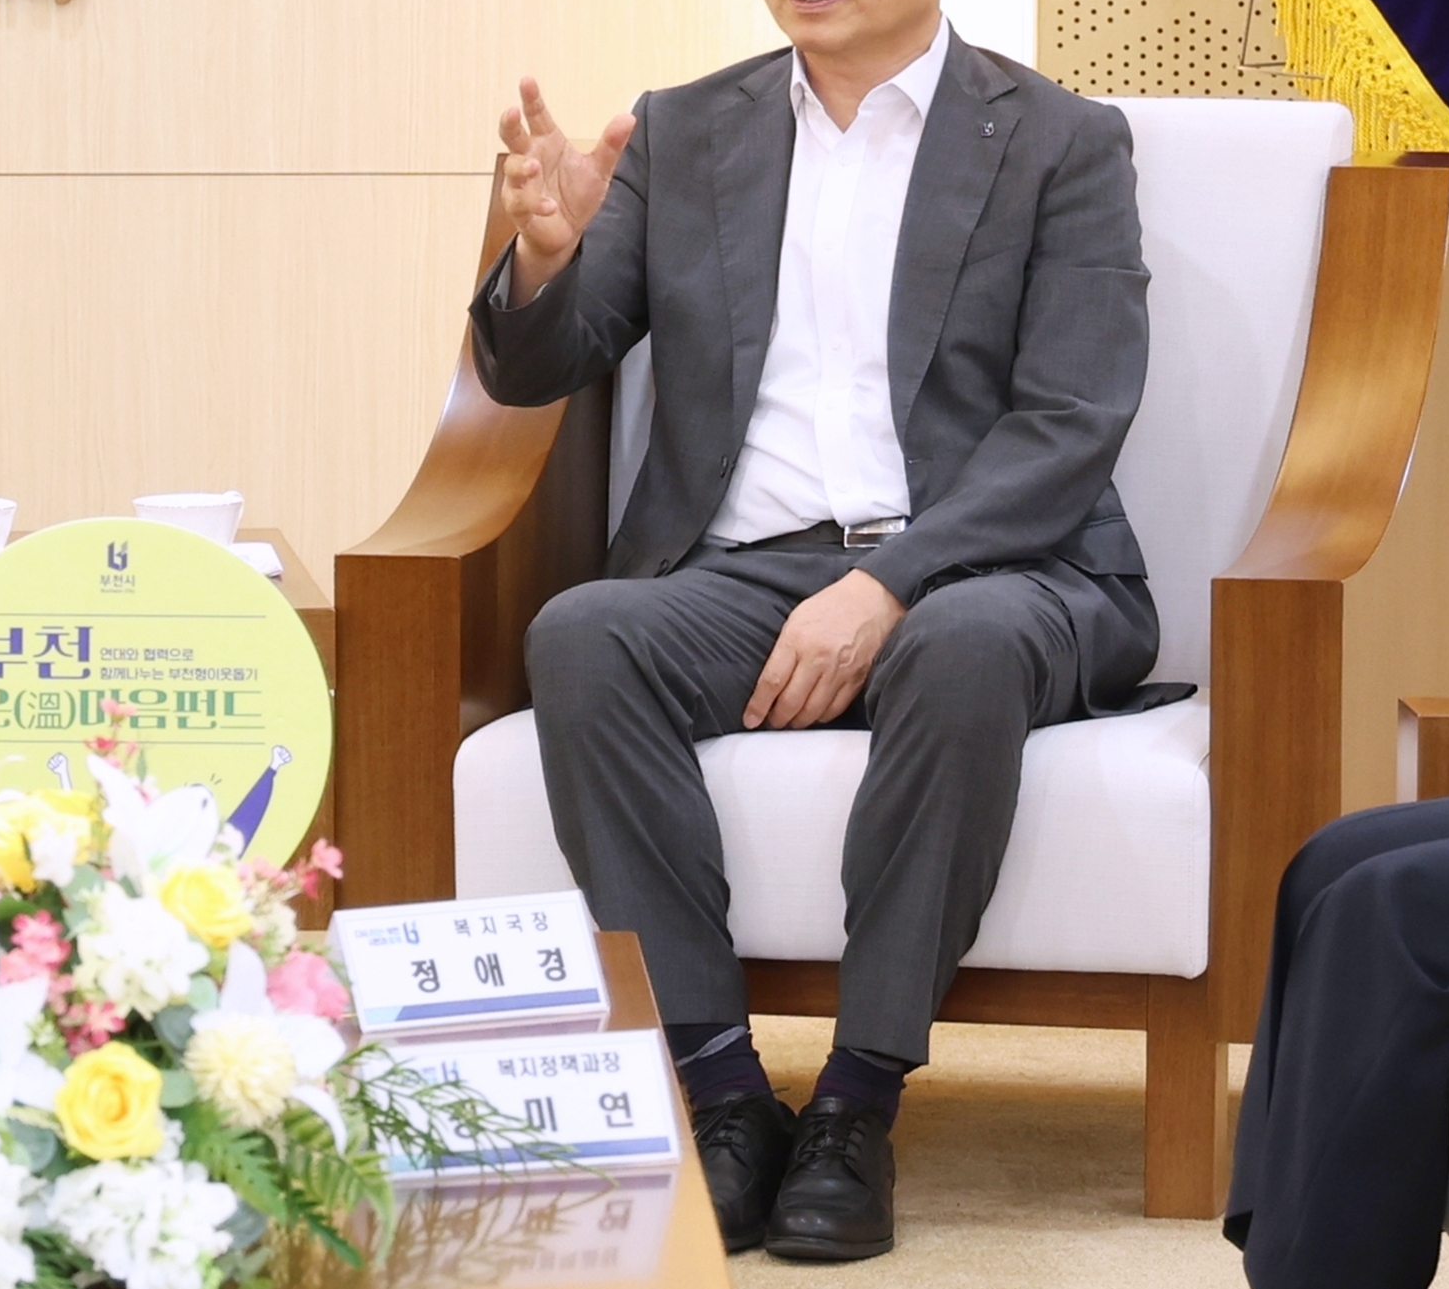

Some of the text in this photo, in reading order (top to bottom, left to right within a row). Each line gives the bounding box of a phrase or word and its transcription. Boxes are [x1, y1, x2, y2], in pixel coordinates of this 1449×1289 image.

[100, 575, 136, 588] 부천시
[100, 648, 194, 661] 연대와 협력으로
[497, 1051, 621, 1078] 복지정책과장
